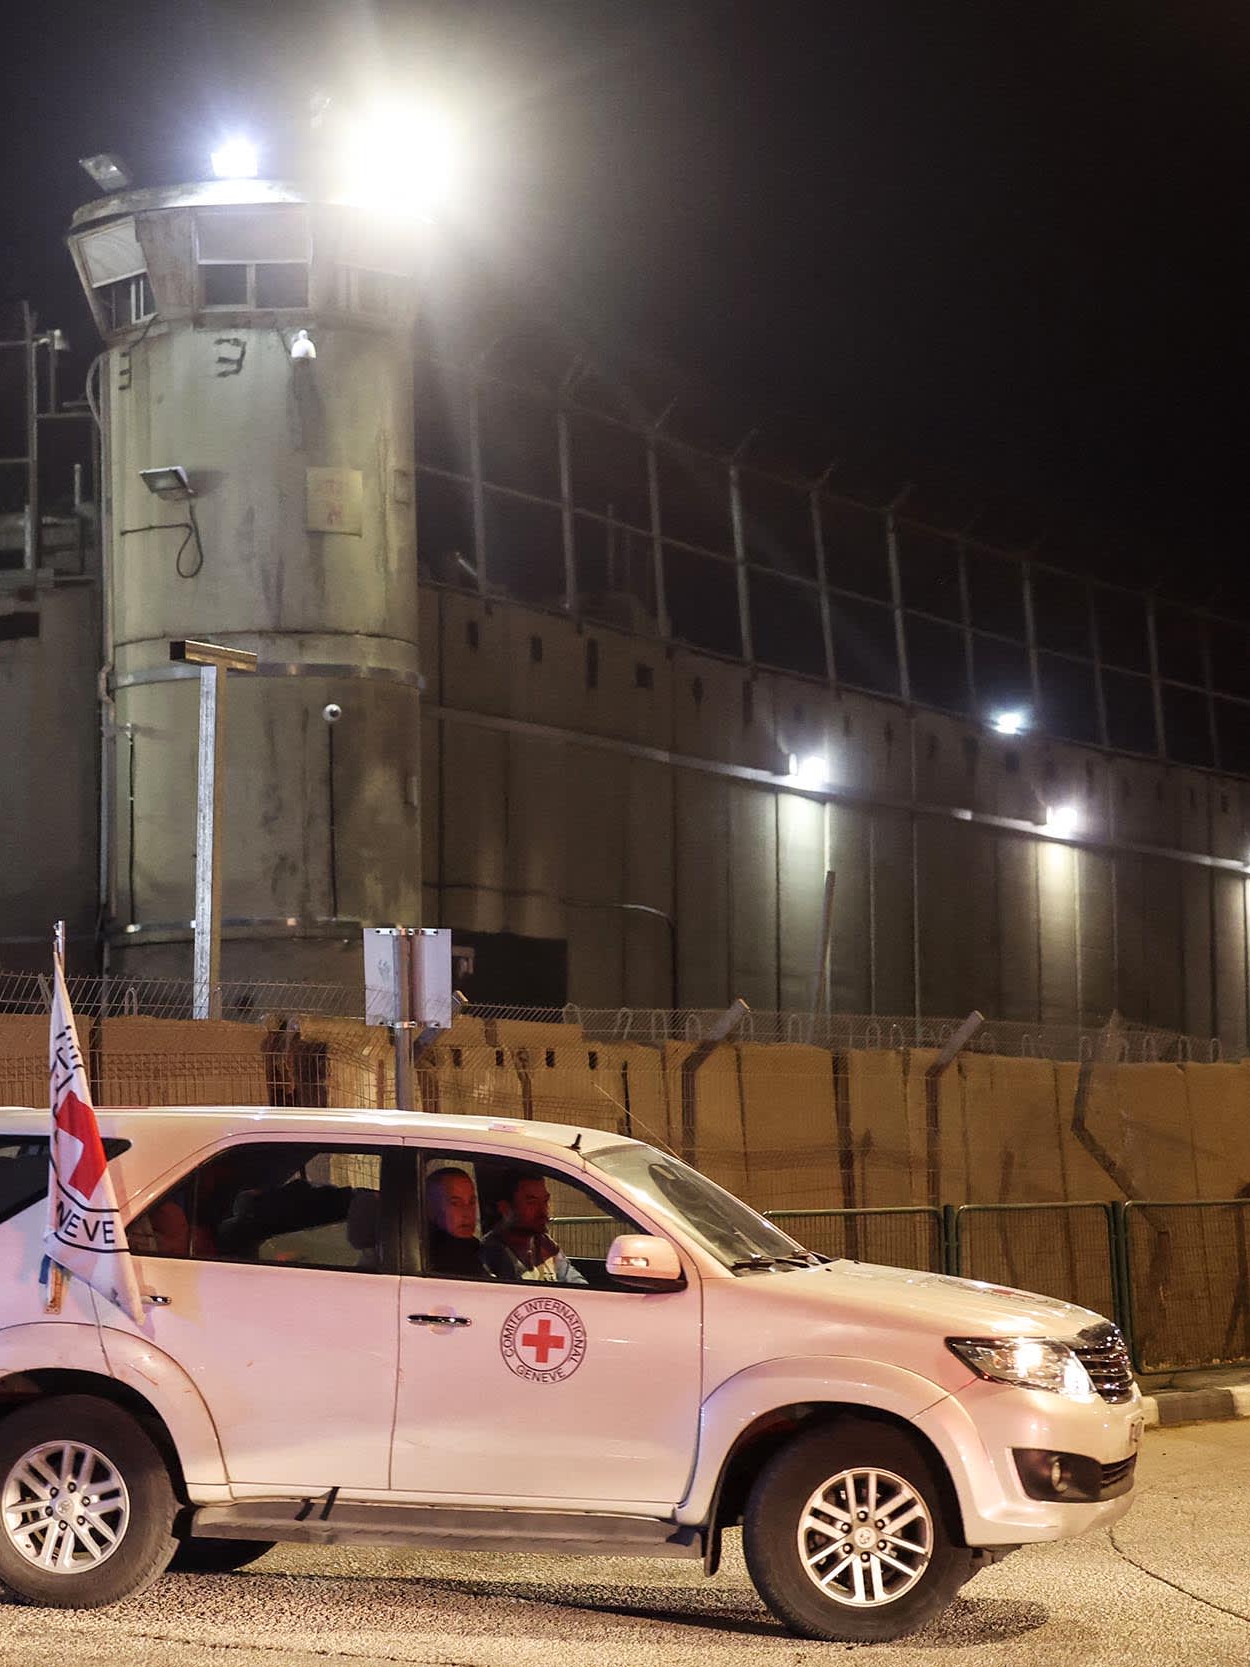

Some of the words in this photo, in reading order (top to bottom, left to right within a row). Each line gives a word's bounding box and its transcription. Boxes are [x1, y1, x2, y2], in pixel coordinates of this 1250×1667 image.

[503, 1310, 524, 1358] COMITE
[524, 1300, 583, 1364] INTERNATIONAL
[516, 1364, 566, 1383] GENEVE
